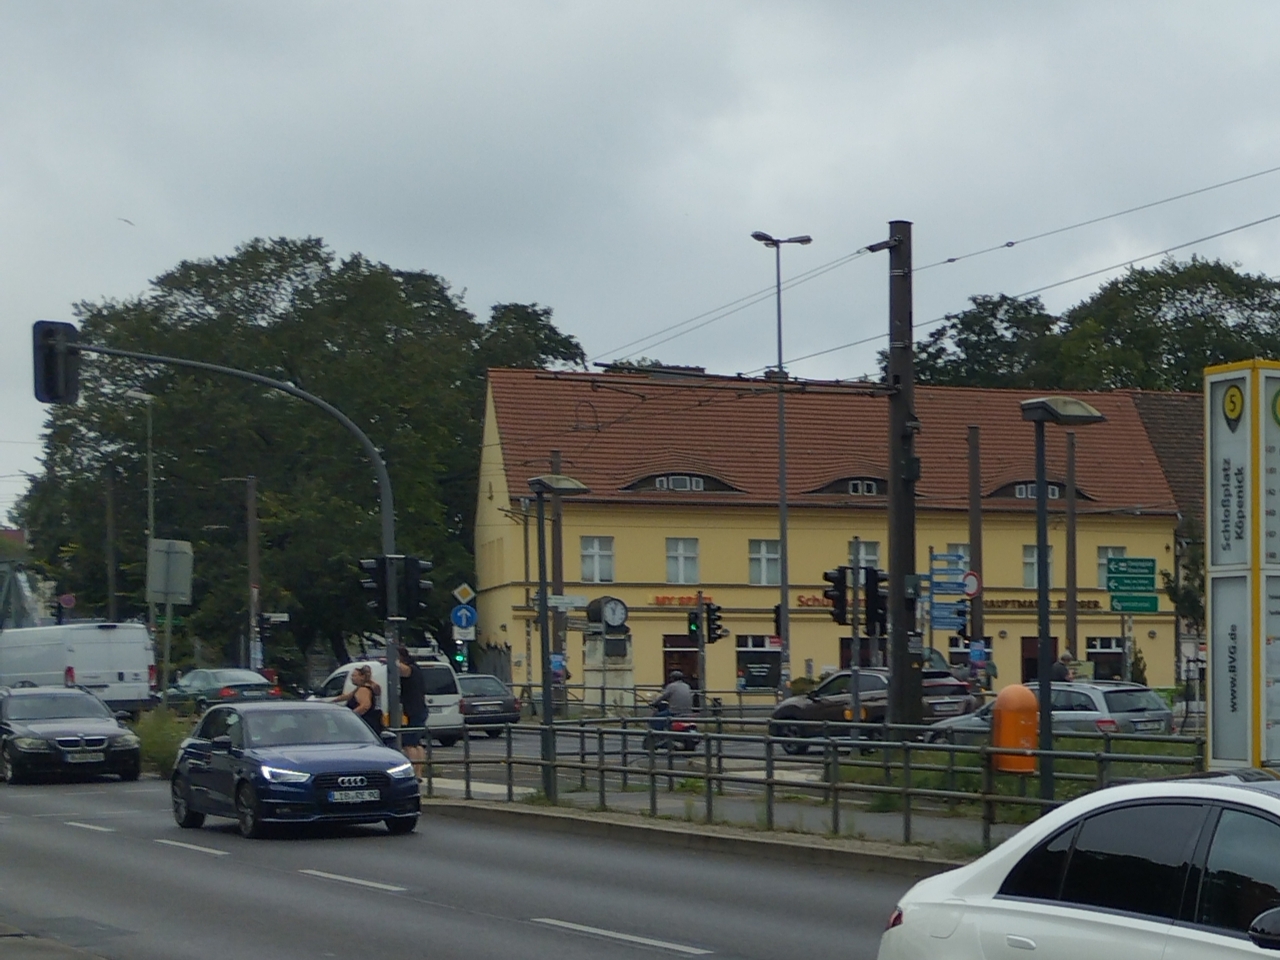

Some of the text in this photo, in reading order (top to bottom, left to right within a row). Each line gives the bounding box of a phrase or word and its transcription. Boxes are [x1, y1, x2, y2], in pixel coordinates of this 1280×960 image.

[1229, 394, 1237, 412] 5
[1221, 458, 1233, 551] Schloßplatz
[1234, 466, 1246, 540] Köpenick
[1228, 624, 1238, 713] www.BVG.de
